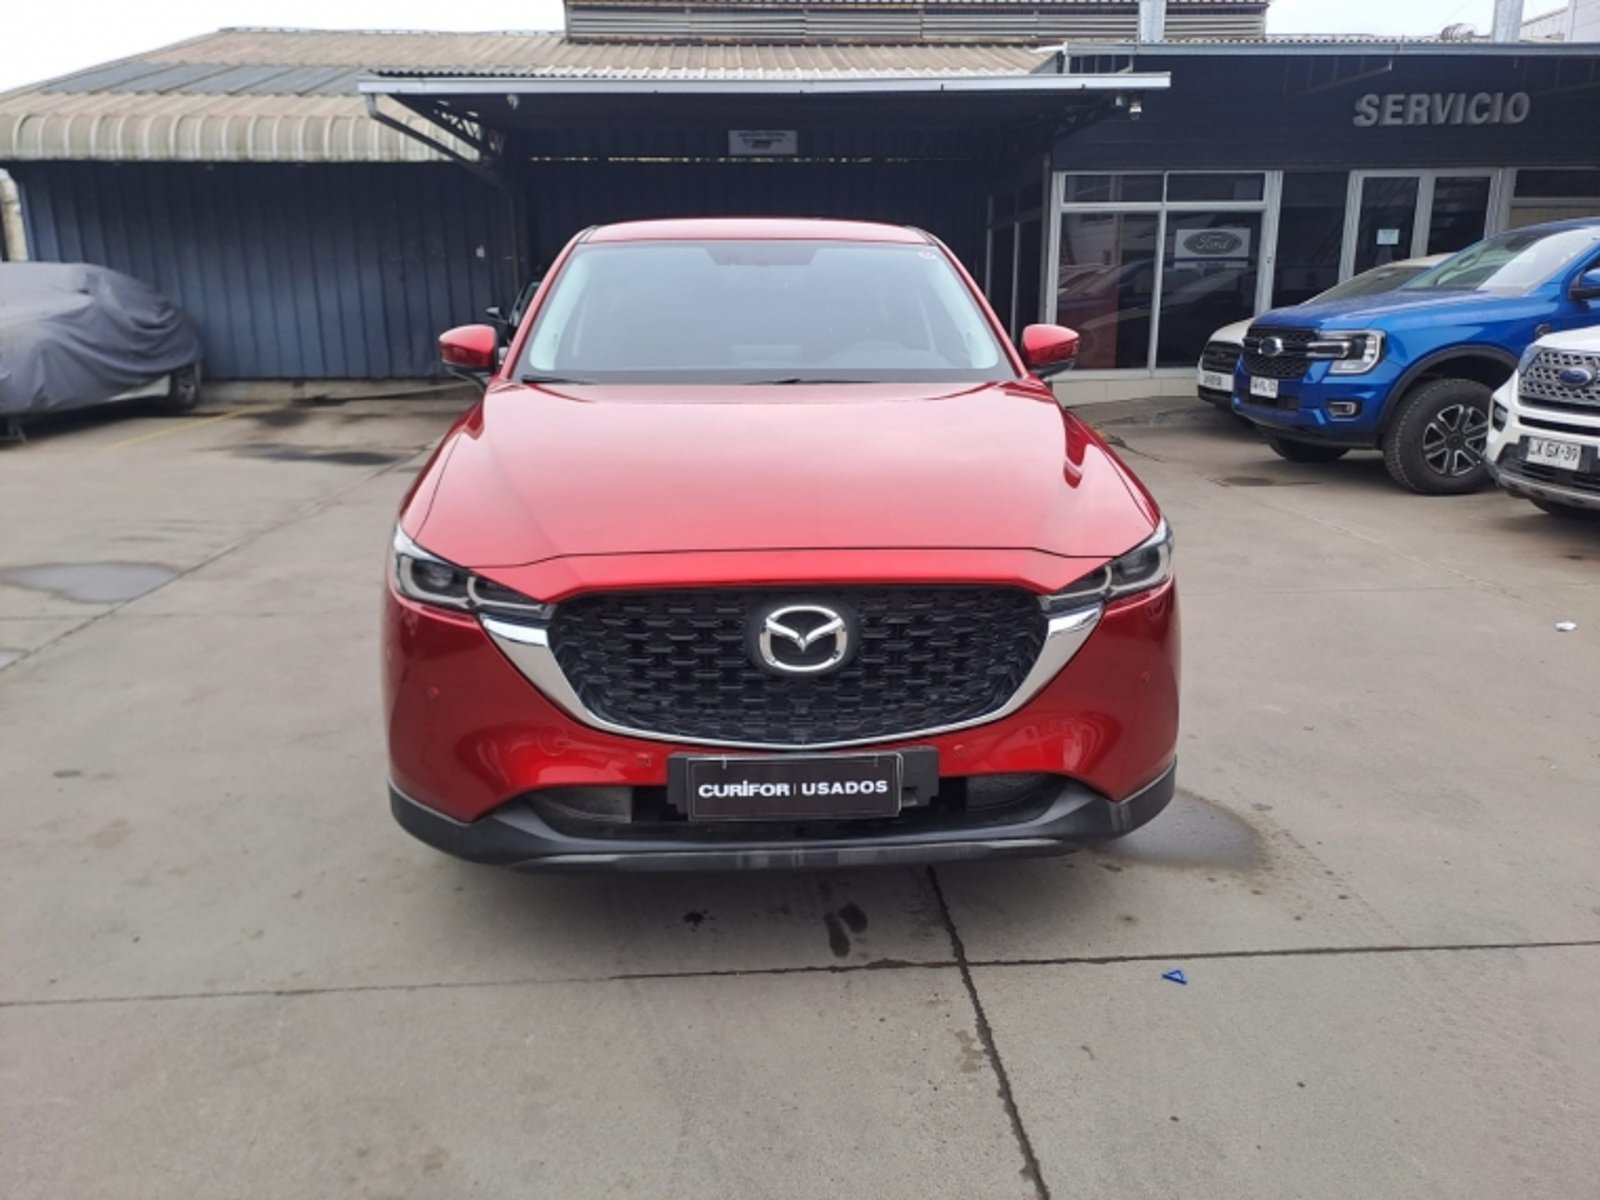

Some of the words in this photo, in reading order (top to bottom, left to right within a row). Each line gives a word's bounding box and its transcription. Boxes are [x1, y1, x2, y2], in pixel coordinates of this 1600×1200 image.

[1353, 92, 1531, 127] SERVICIO
[1195, 233, 1231, 250] Ford
[801, 780, 888, 796] USADOS
